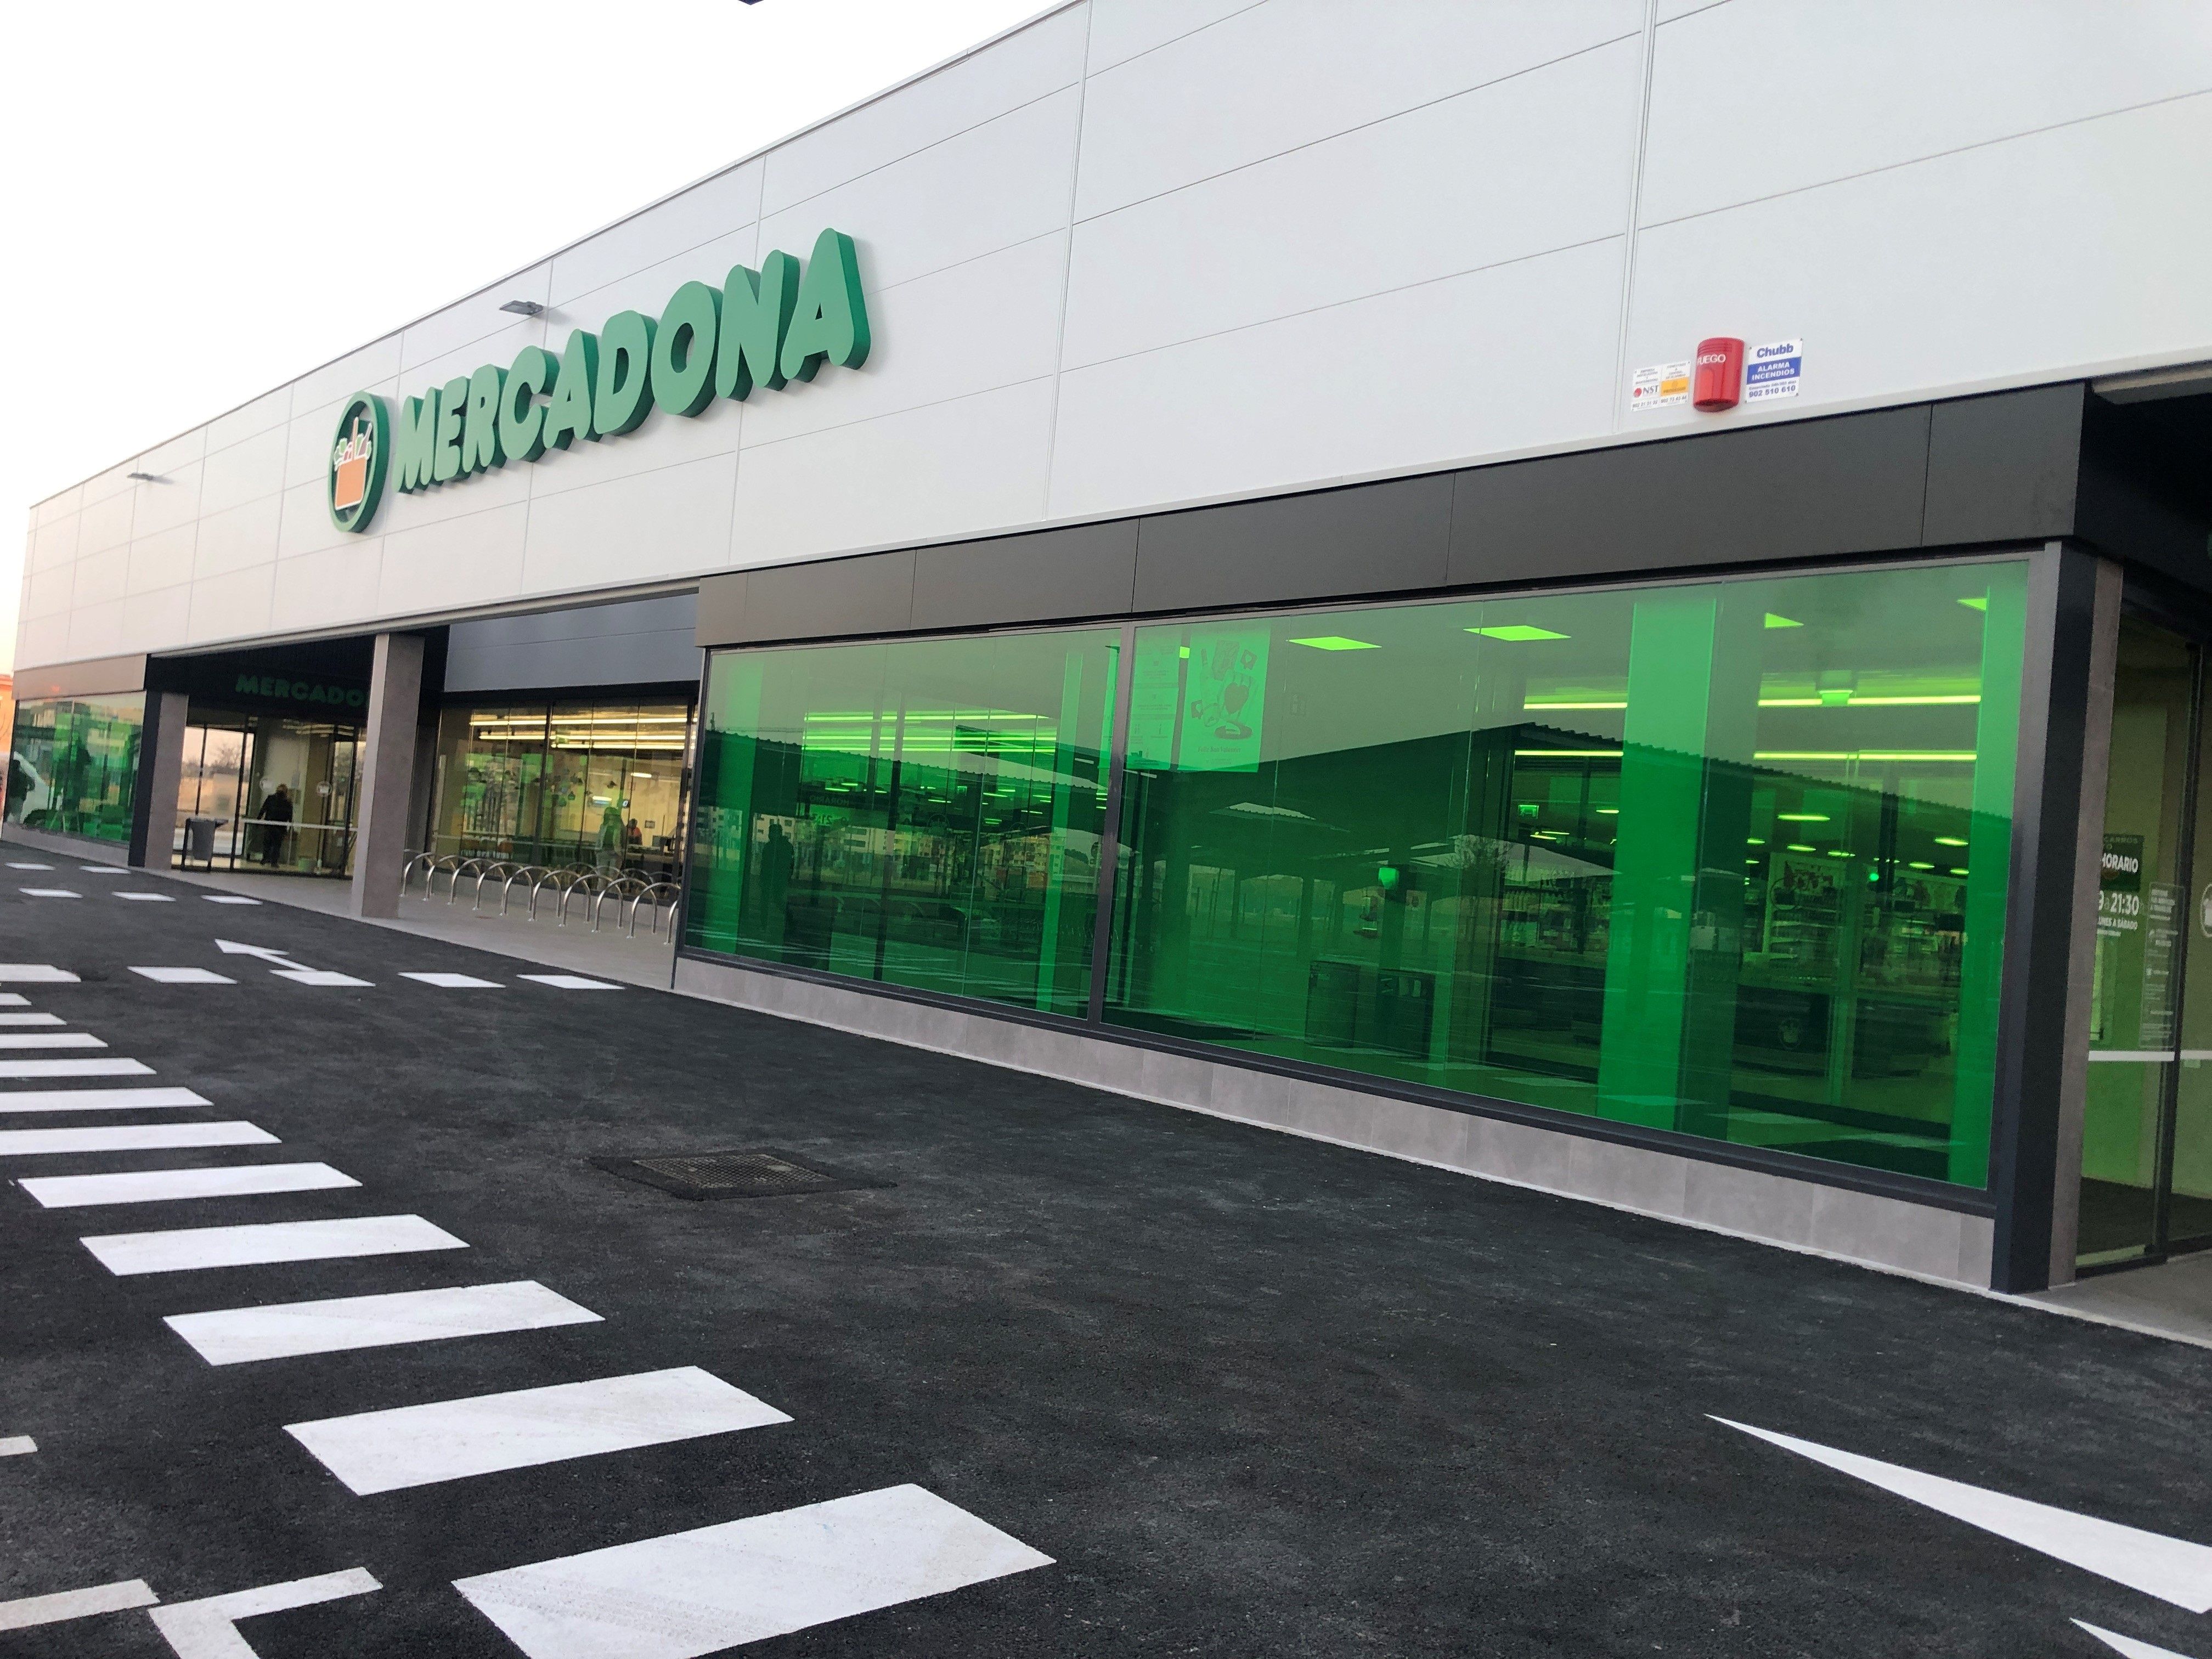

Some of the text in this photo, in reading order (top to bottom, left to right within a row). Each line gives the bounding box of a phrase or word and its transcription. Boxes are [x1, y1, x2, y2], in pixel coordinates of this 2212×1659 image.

[1757, 343, 1793, 358] Chubb
[393, 228, 871, 493] MERCADONA
[1757, 362, 1790, 373] ALARMA
[1752, 368, 1795, 381] INCENDIOS
[1643, 385, 1658, 394] NST
[235, 675, 369, 707] MERCADO
[2111, 892, 2140, 916] 21:30
